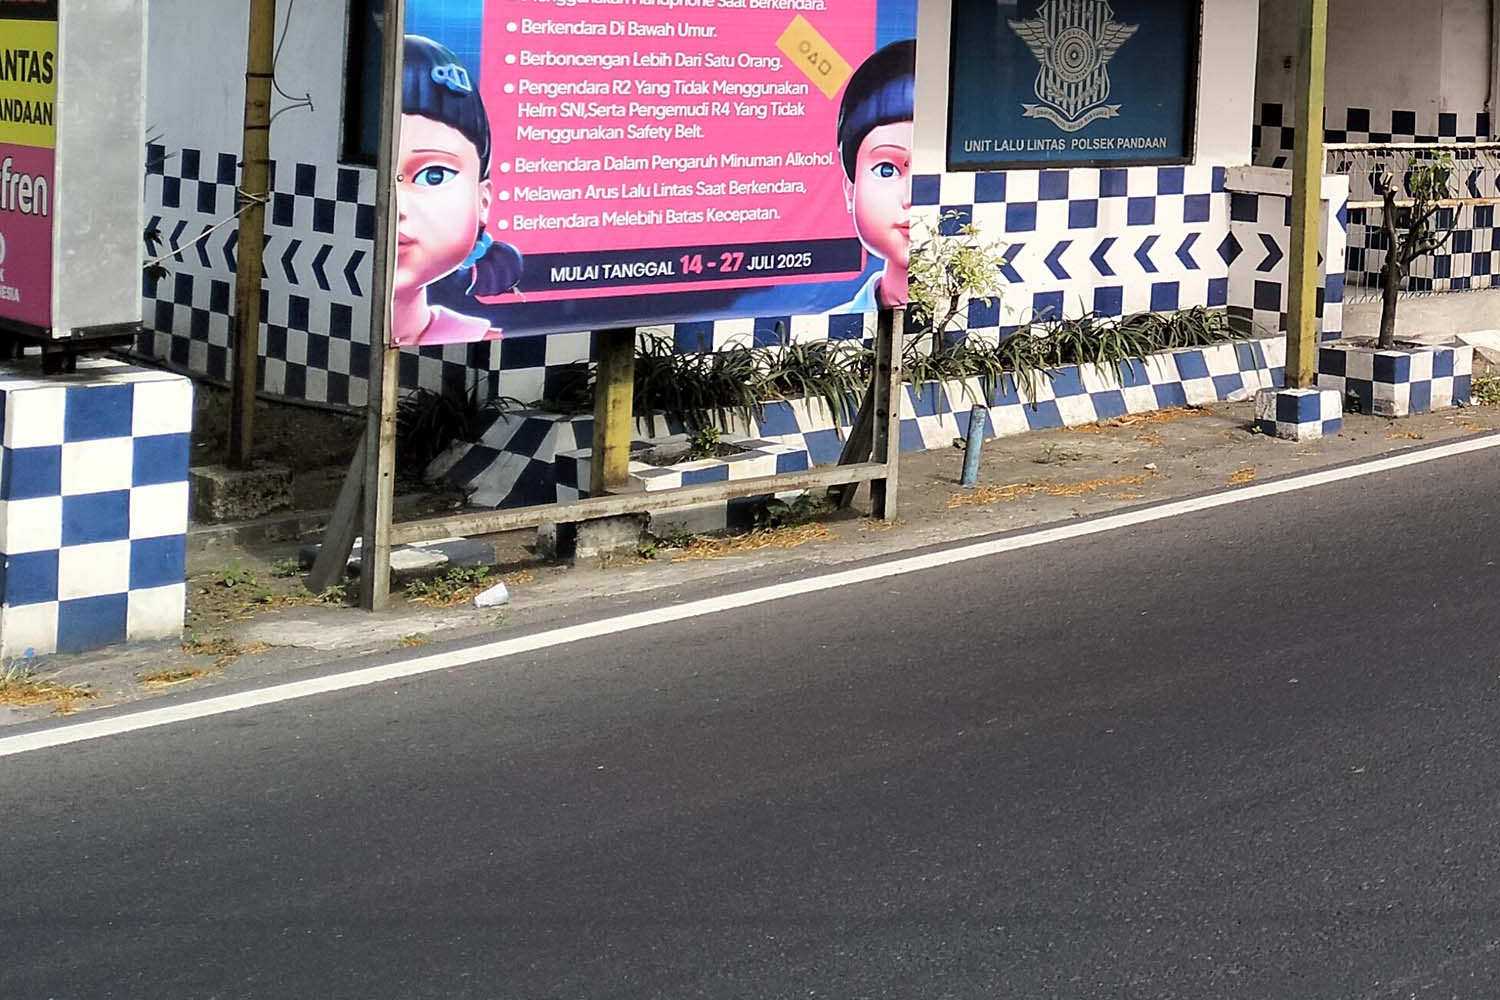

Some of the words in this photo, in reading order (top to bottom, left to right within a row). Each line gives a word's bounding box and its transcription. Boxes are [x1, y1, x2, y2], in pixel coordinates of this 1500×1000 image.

[520, 18, 607, 36] Berkendara
[609, 20, 625, 36] Di
[627, 20, 675, 37] Bawah
[678, 22, 718, 38] Umur.
[519, 50, 631, 70] Berboncengan
[632, 52, 672, 67] Lebih
[674, 52, 702, 67] Dari
[704, 52, 735, 68] Satu
[737, 53, 783, 71] Orang.
[518, 79, 610, 98] Pengendara
[612, 80, 632, 95] R2
[634, 79, 671, 98] Yang
[673, 80, 710, 95] Tidak
[712, 80, 809, 98] Menggunakan
[517, 102, 557, 119] Helm
[629, 102, 709, 120] Pengemudi
[711, 102, 731, 117] R4
[733, 102, 767, 119] Yang
[770, 102, 806, 117] Tidak
[516, 125, 624, 144] Menggunakan
[627, 124, 672, 142] Safety
[674, 124, 704, 139] Belt.
[964, 139, 993, 153] UNIT
[994, 138, 1025, 152] LALU
[1026, 138, 1067, 151] LINTAS
[1071, 137, 1116, 150] POLSEK
[1116, 136, 1168, 150] PANDAAN
[514, 157, 601, 174] Berkendara
[603, 155, 649, 172] Dalam
[651, 155, 718, 172] Pengaruh
[720, 153, 783, 169] Minuman
[785, 152, 836, 166] Alkohol.
[513, 186, 582, 202] Melawan
[584, 184, 619, 200] Arus
[621, 183, 651, 199] Lalu
[653, 182, 694, 197] Lintas
[695, 181, 726, 196] Saat
[729, 179, 807, 195] Berkendara,
[513, 214, 600, 231] Berkendara
[602, 210, 663, 227] Melebihi
[665, 209, 704, 225] Batas
[706, 207, 781, 224] Kecepatan.
[551, 265, 599, 283] MULAI
[602, 261, 675, 280] TANGGAL
[680, 254, 704, 275] 14
[720, 252, 745, 273] 27
[747, 254, 775, 271] JULI
[777, 252, 812, 269] 2025
